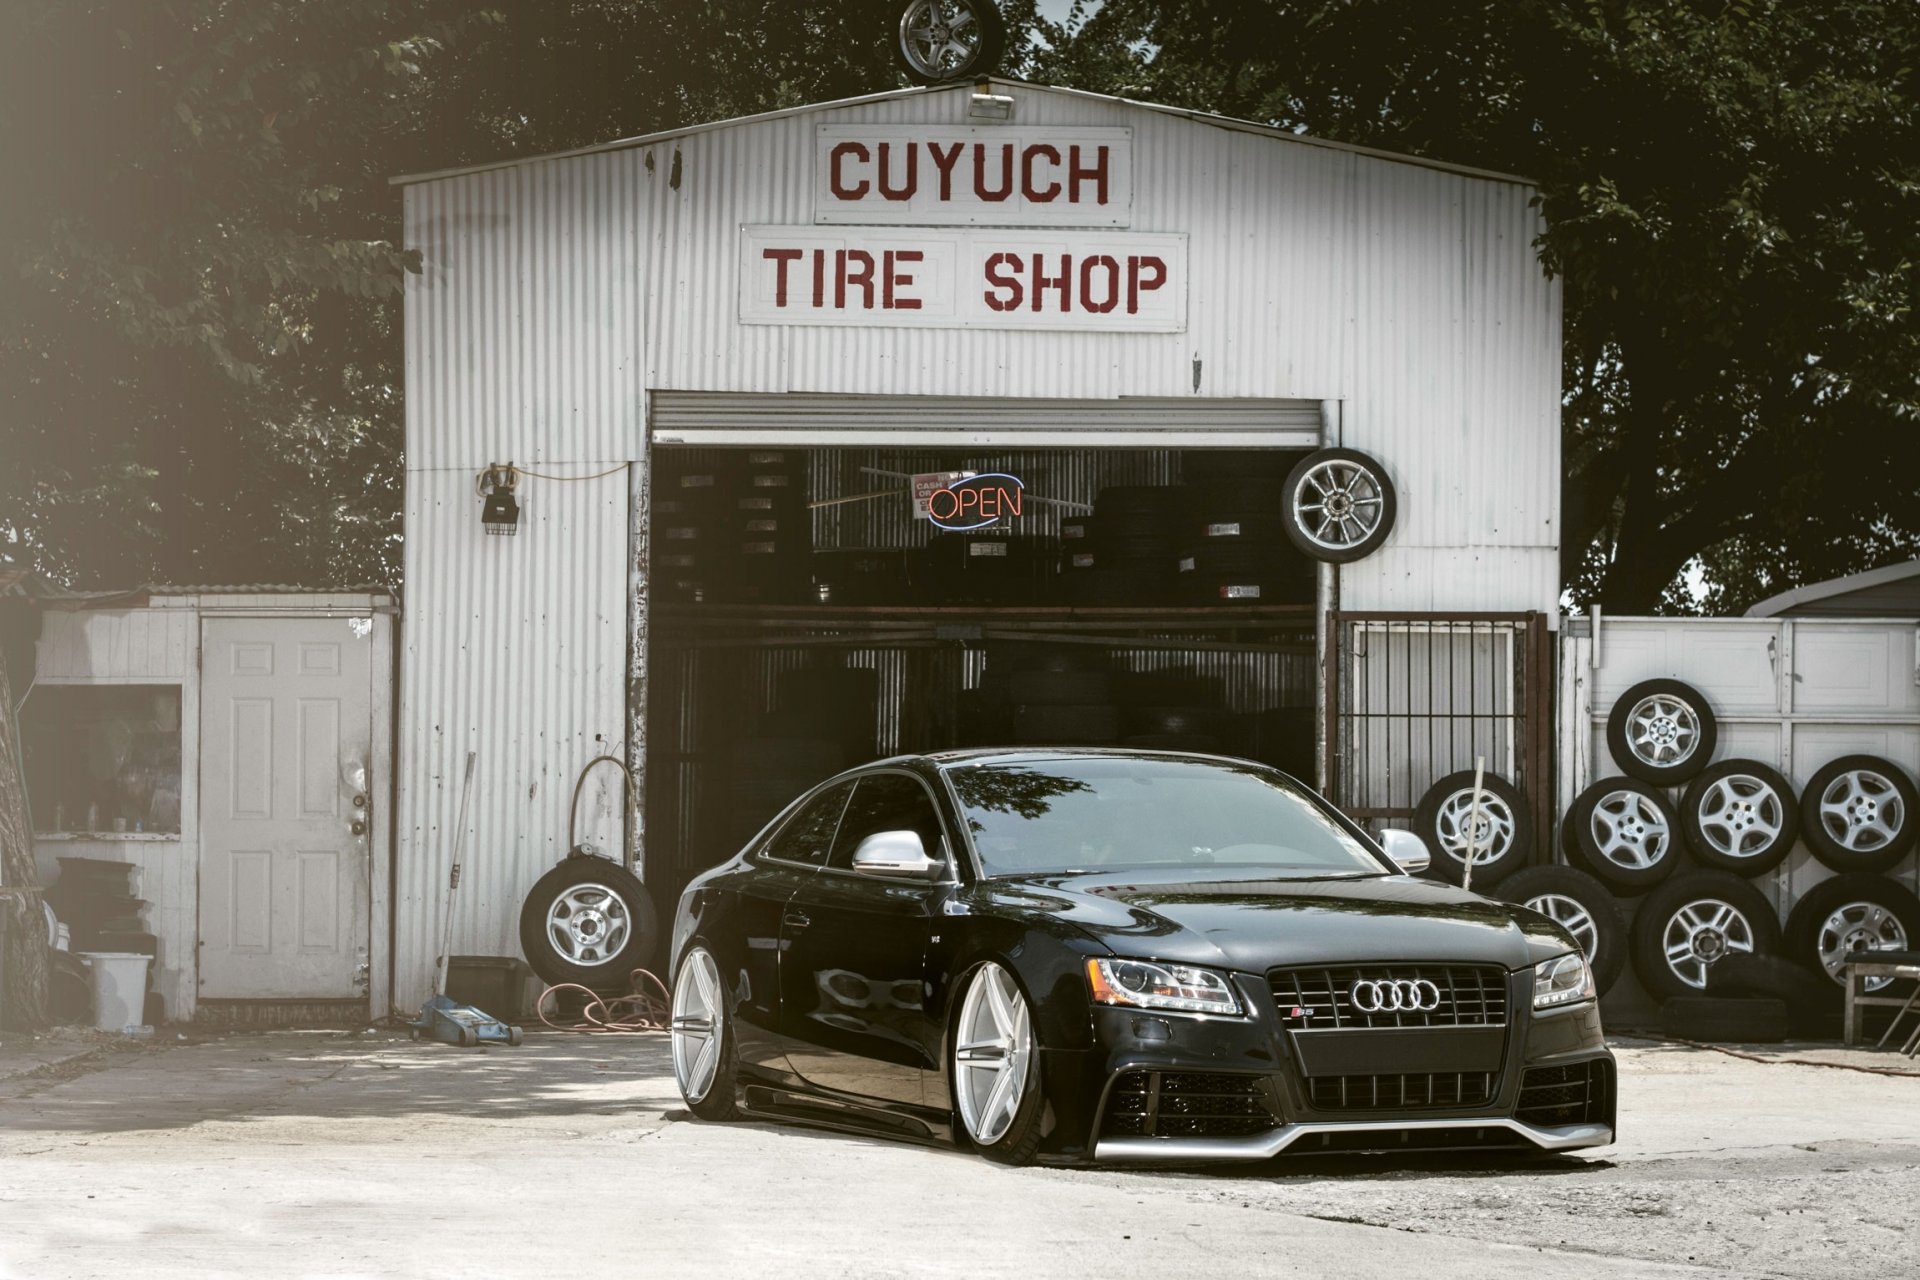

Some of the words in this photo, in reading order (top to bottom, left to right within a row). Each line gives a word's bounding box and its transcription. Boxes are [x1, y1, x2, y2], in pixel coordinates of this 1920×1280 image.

[830, 141, 1109, 205] CUYUCH
[763, 248, 924, 310] TIRE
[984, 252, 1167, 315] SHOP
[916, 481, 943, 490] CASH
[929, 486, 1021, 519] OPEN
